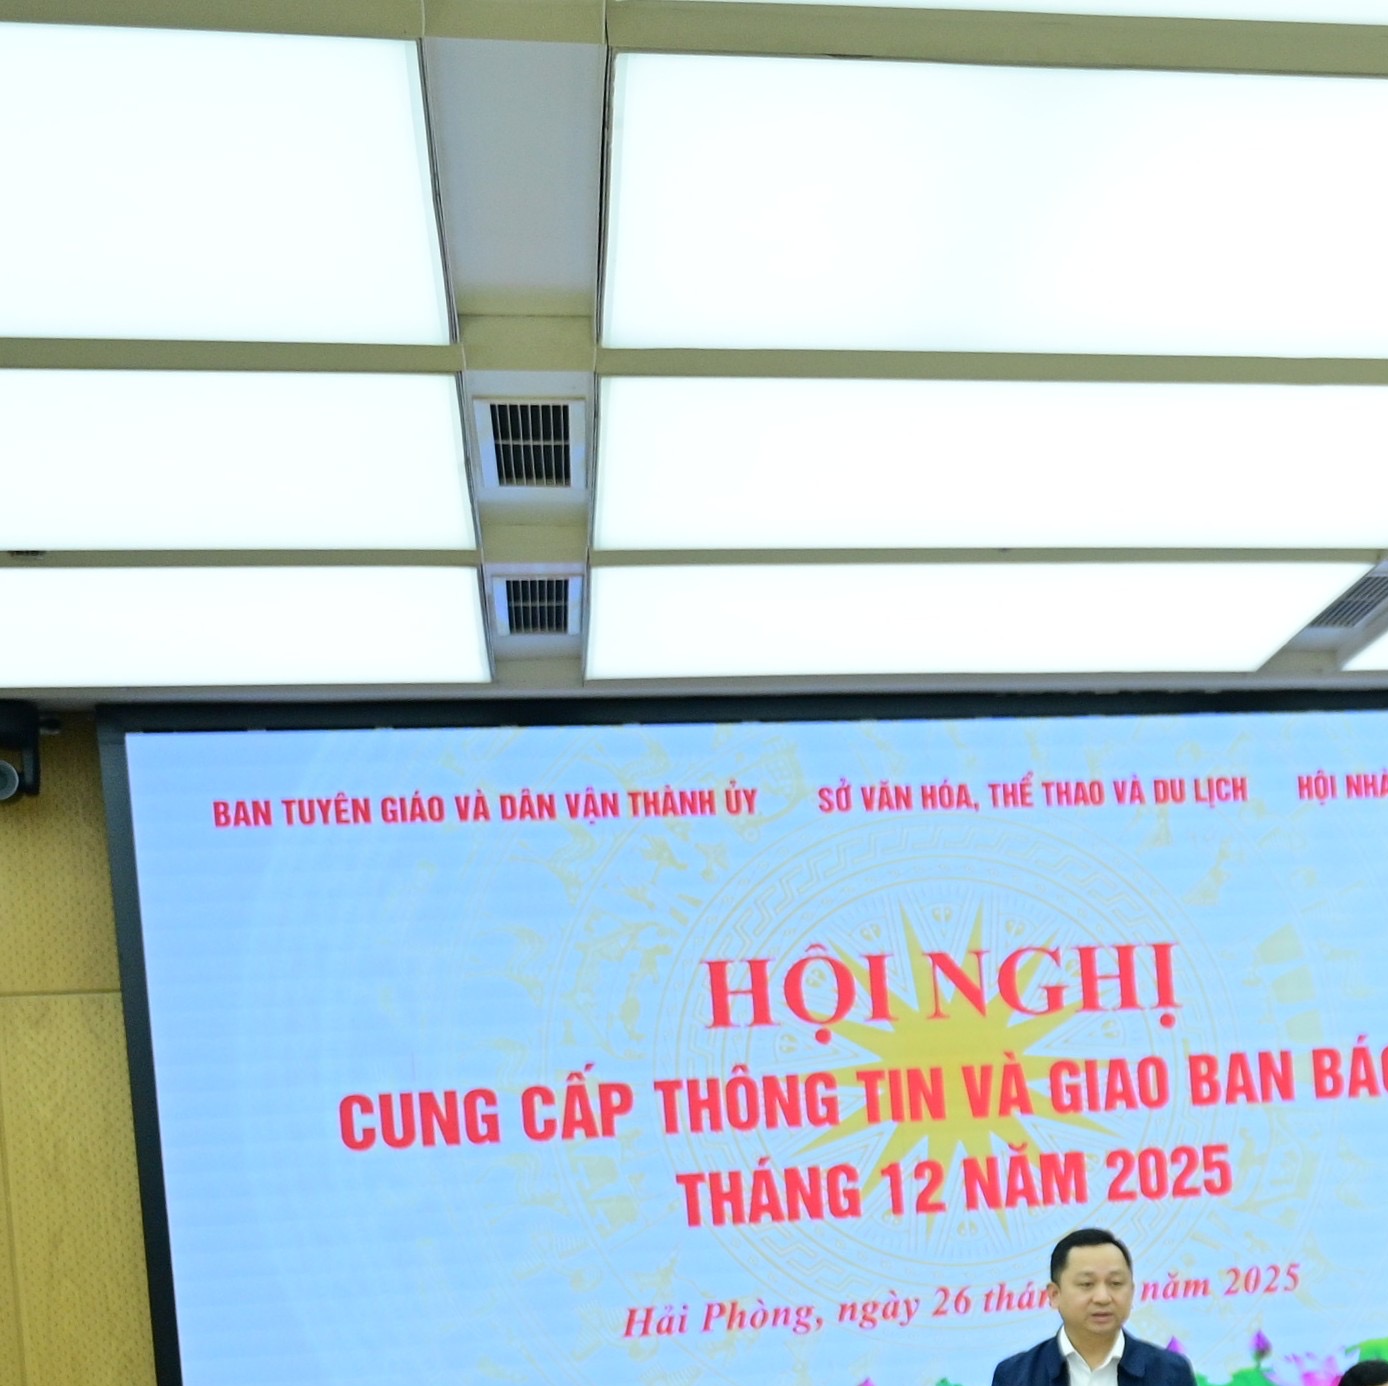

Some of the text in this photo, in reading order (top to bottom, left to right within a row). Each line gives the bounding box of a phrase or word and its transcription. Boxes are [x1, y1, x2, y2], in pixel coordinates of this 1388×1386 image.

[213, 778, 758, 828] BAN TUYÊN GIÁO VÀ DÂN VẬN THÀNH ỦY
[818, 770, 1248, 814] SỞ VĂN HÓA, THỂ THAO VÀ DU LỊCH
[1297, 770, 1338, 805] HỘI
[701, 942, 1182, 1045] HỘI NGHỊ
[338, 1087, 501, 1153] CUNG
[520, 1062, 634, 1142] CẤP
[653, 1063, 840, 1135] THÔNG
[855, 1066, 947, 1125] TIN
[960, 1051, 1034, 1120] VÀ
[1048, 1055, 1170, 1115] GIAO
[1188, 1050, 1296, 1108] BAN
[675, 1142, 1233, 1228] THÁNG 12 NĂM 2025
[1140, 1262, 1301, 1302] năm 2025
[622, 1302, 690, 1339] Hải
[701, 1298, 825, 1335] Phòng,
[838, 1289, 920, 1330] ngày
[932, 1285, 972, 1317] 26
